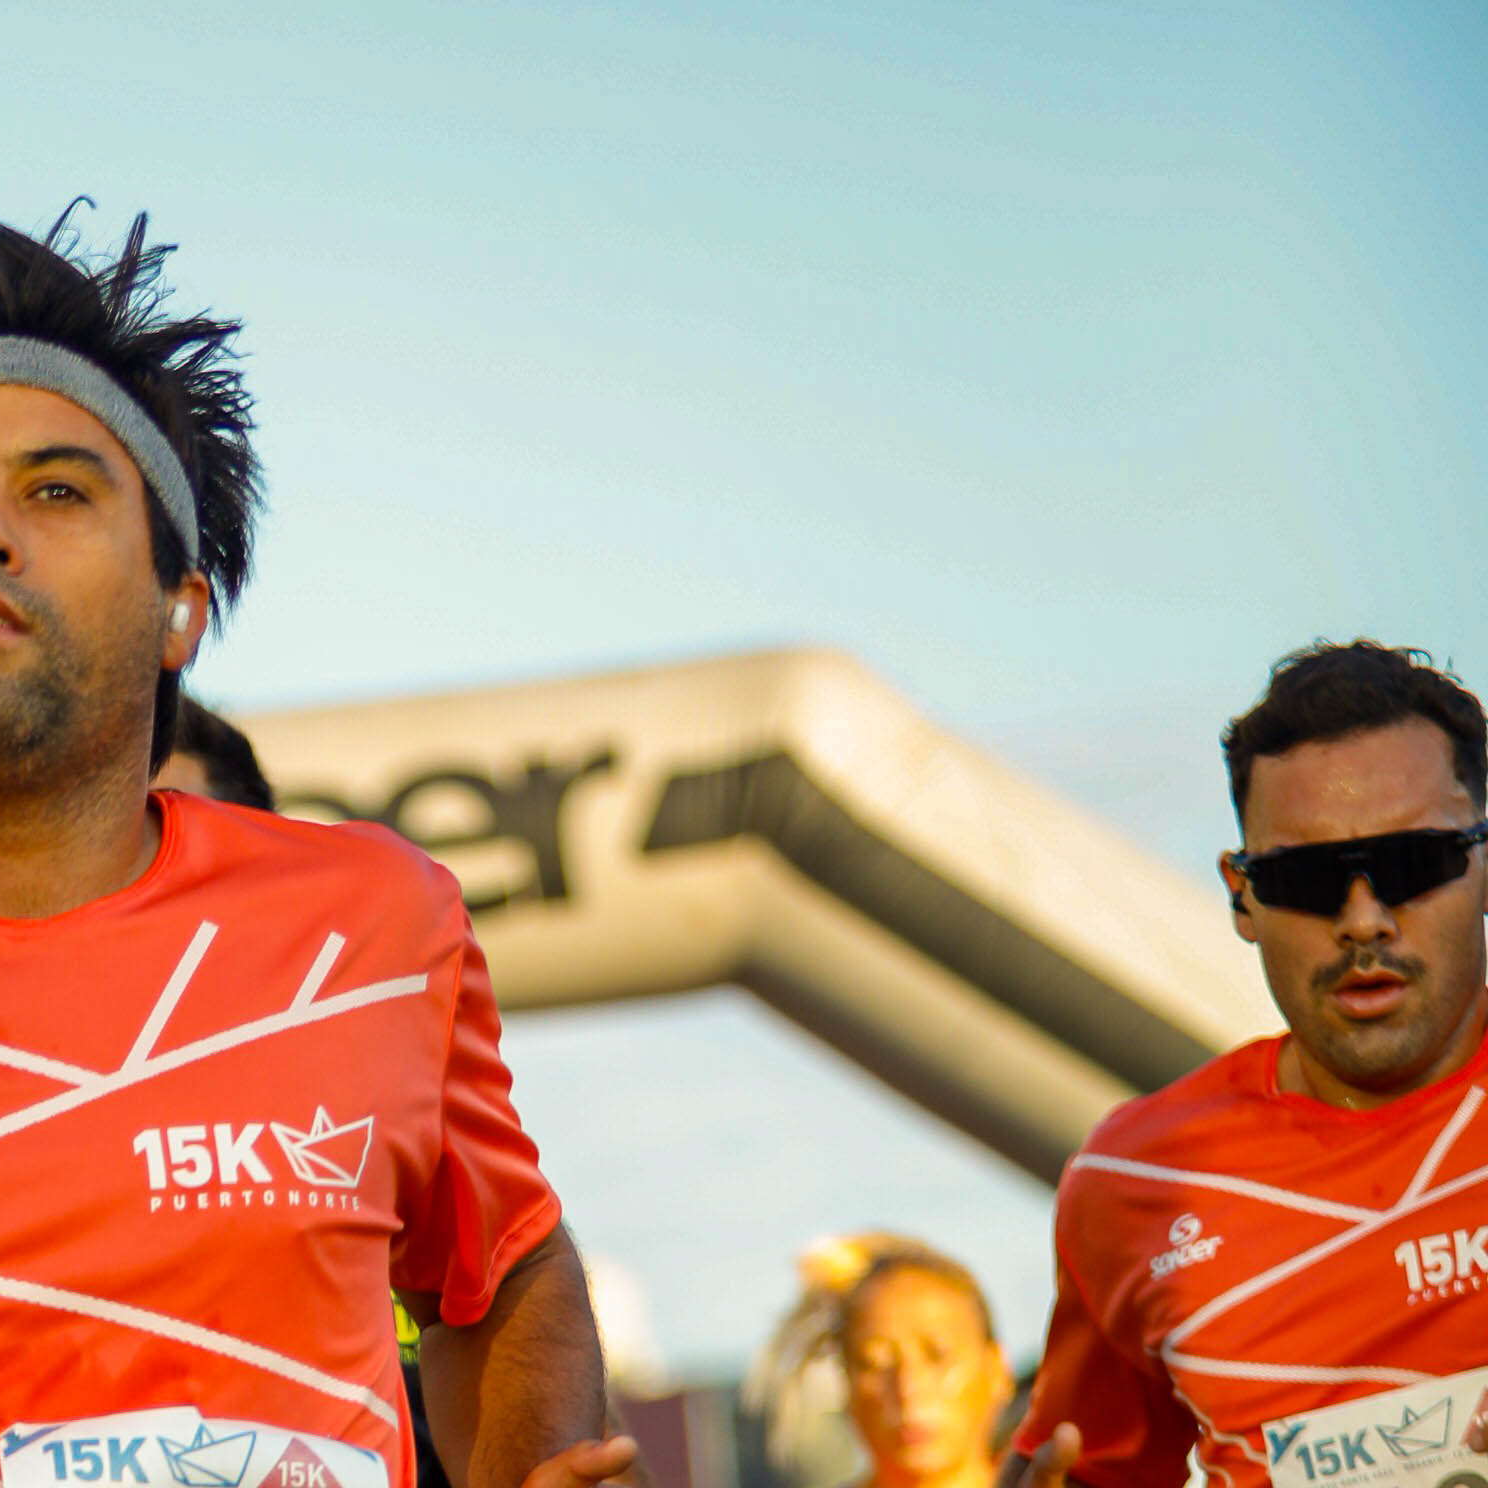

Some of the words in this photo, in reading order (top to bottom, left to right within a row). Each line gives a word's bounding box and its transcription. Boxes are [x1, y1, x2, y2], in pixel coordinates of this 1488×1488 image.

[133, 1123, 272, 1190] 15K
[150, 1190, 277, 1213] PUERTO
[288, 1190, 360, 1211] NORTE
[42, 1437, 149, 1483] 15K
[277, 1461, 327, 1488] 15K
[1296, 1427, 1376, 1480] 15K
